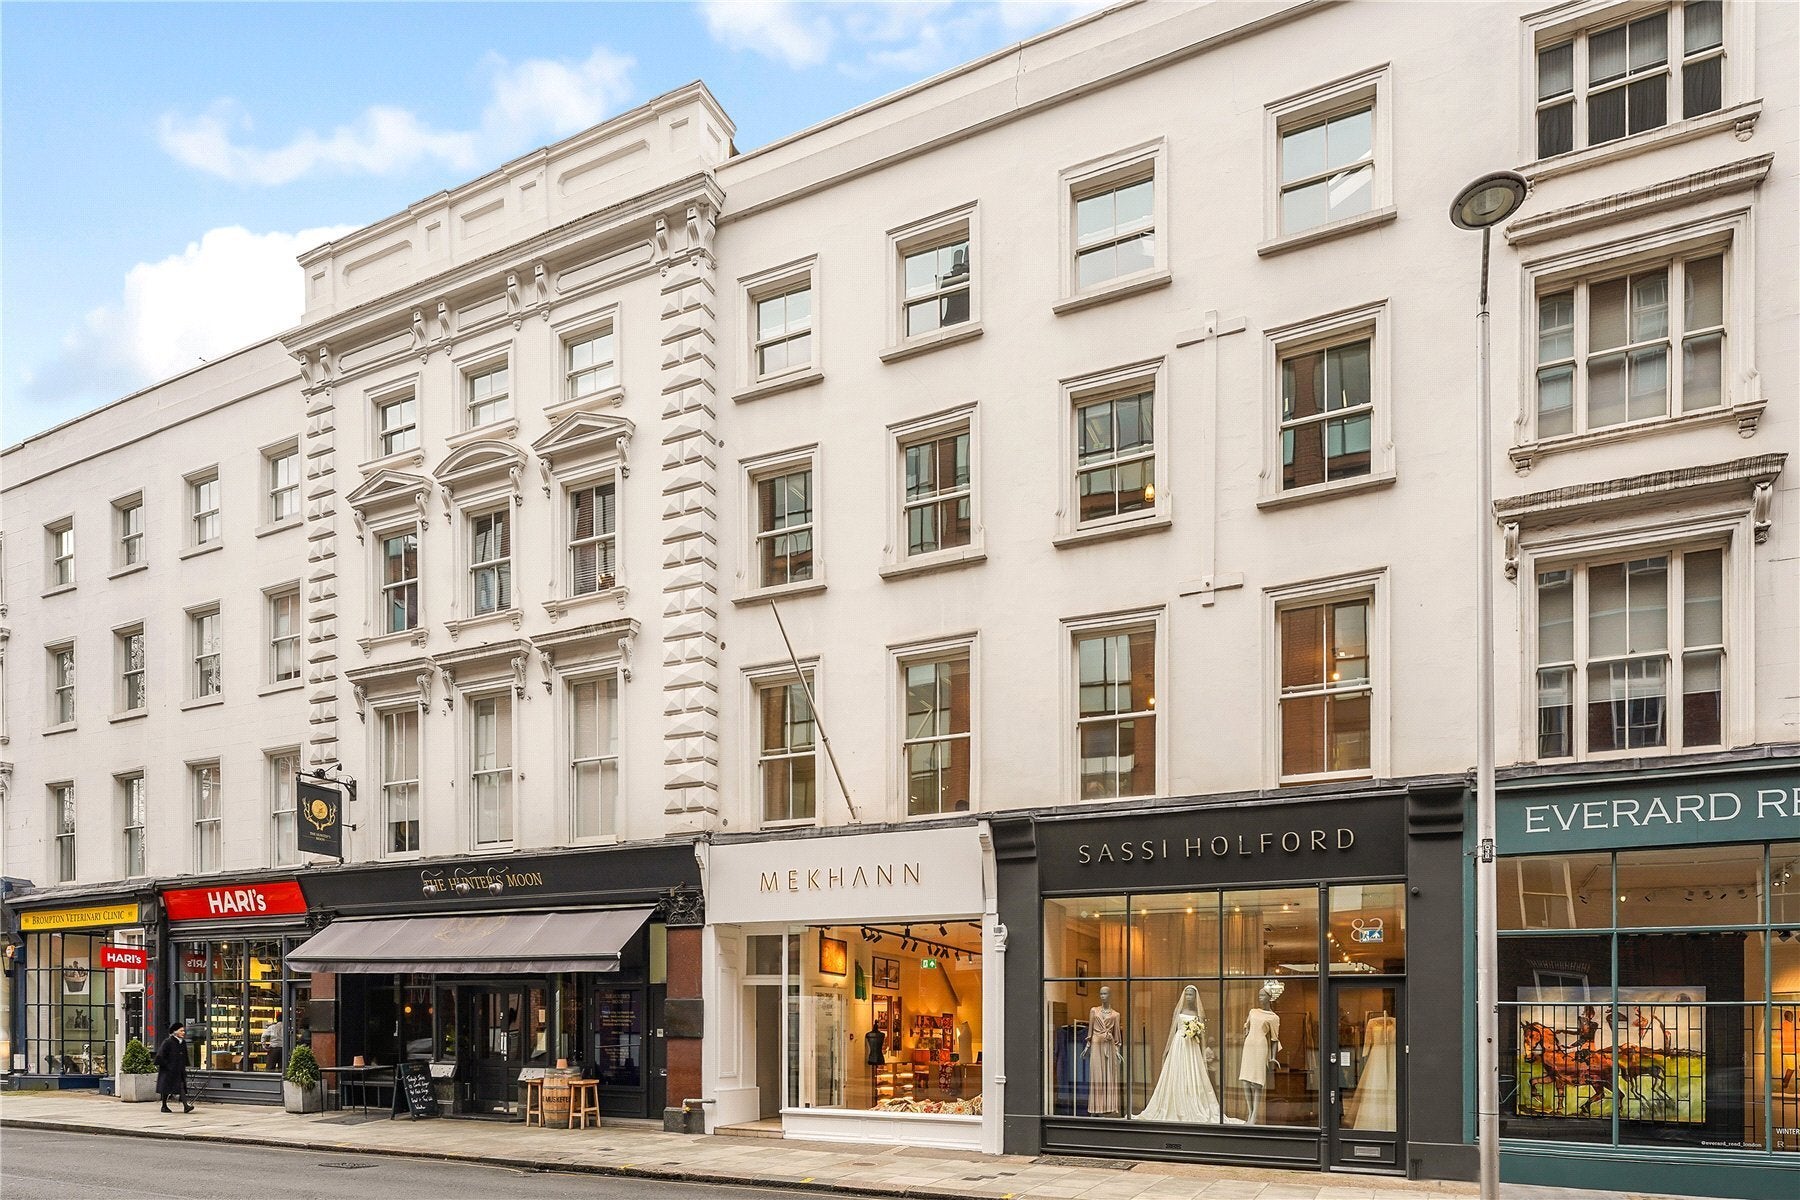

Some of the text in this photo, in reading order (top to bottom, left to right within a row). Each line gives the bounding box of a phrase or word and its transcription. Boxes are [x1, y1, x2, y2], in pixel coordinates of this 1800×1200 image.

[1525, 792, 1742, 833] EVERARD
[1078, 828, 1355, 864] SASSI HOLFORD
[423, 879, 447, 892] THE
[506, 872, 543, 888] MOON
[760, 862, 920, 892] MEKHANN
[207, 889, 267, 914] HARI's
[32, 915, 65, 925] BROMPTON
[66, 912, 101, 923] VETERINARY
[102, 910, 125, 920] CLINIC
[106, 952, 142, 964] HARI's
[545, 1095, 578, 1103] MUSKETES
